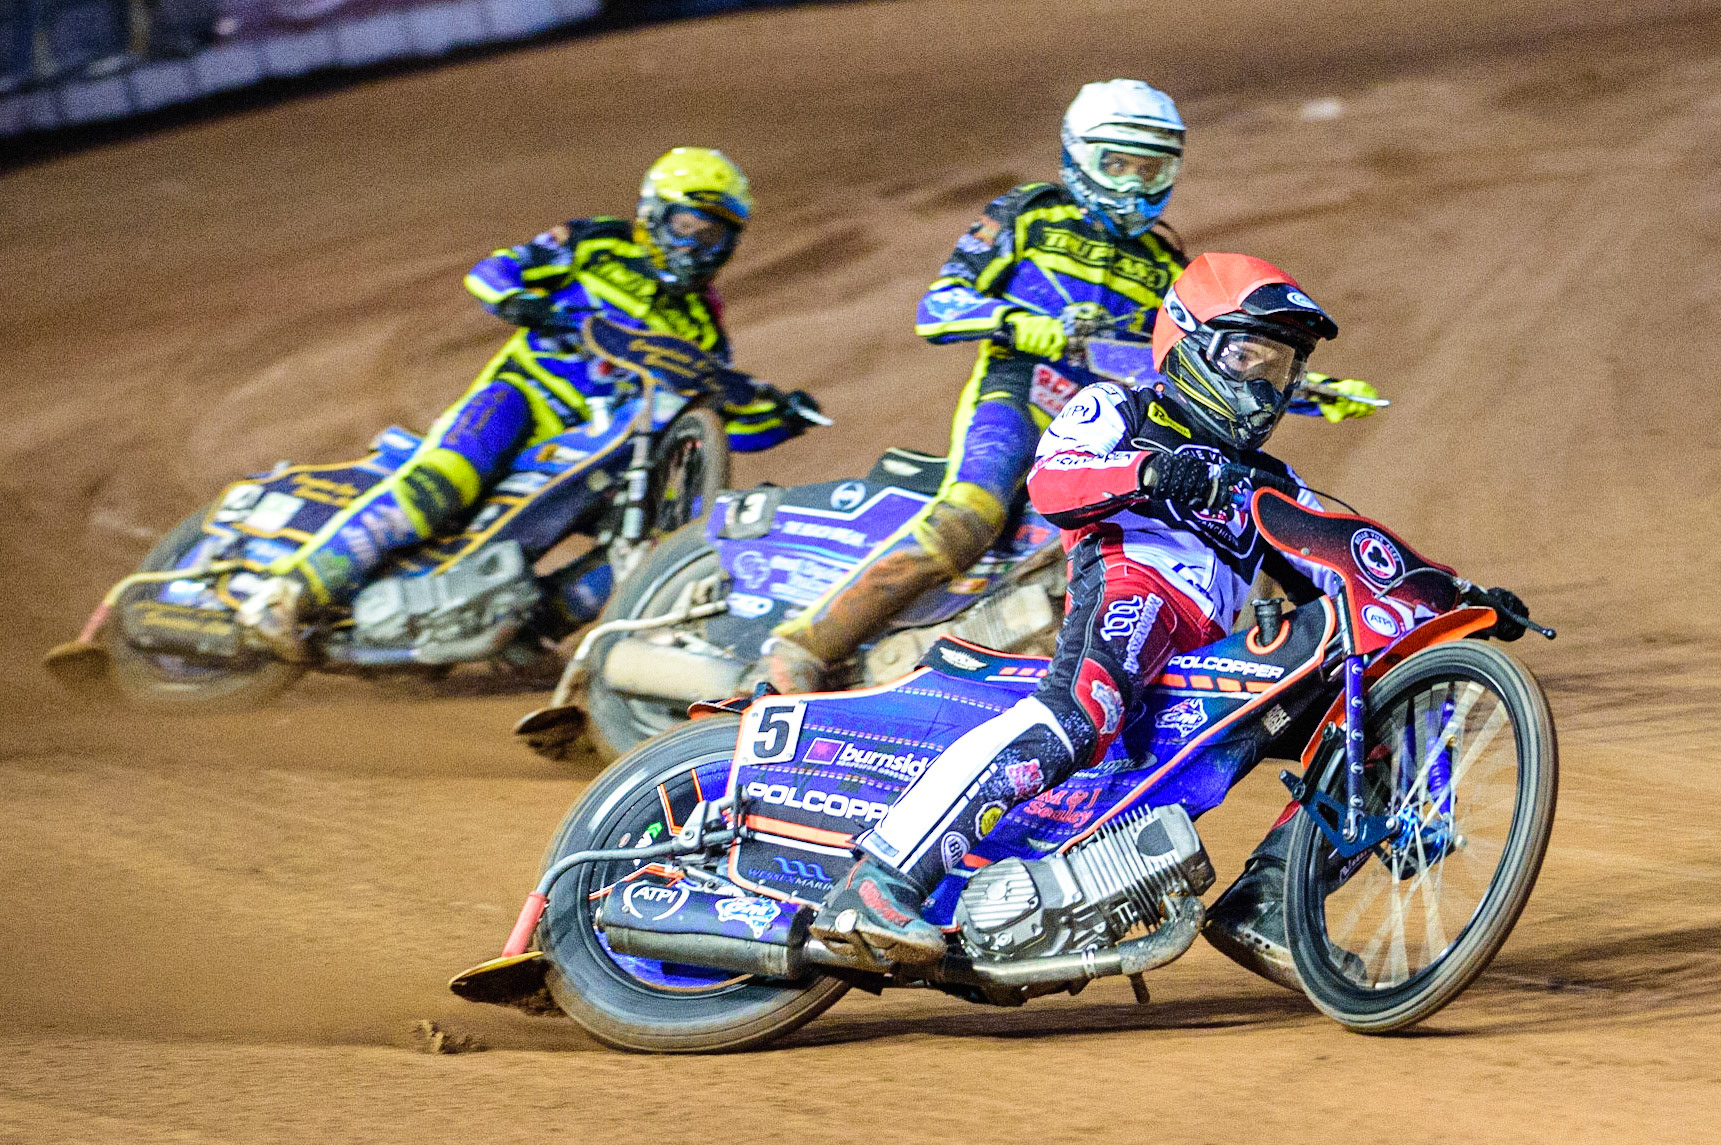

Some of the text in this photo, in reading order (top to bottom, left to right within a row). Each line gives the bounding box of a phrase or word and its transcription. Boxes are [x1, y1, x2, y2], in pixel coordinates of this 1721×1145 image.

[1167, 655, 1285, 679] POLCOPPER
[753, 705, 796, 759] 5
[838, 743, 930, 777] burnsid
[746, 781, 891, 823] POLCOPP
[747, 867, 834, 891] WESSEXMARIN
[632, 886, 679, 904] ATPI
